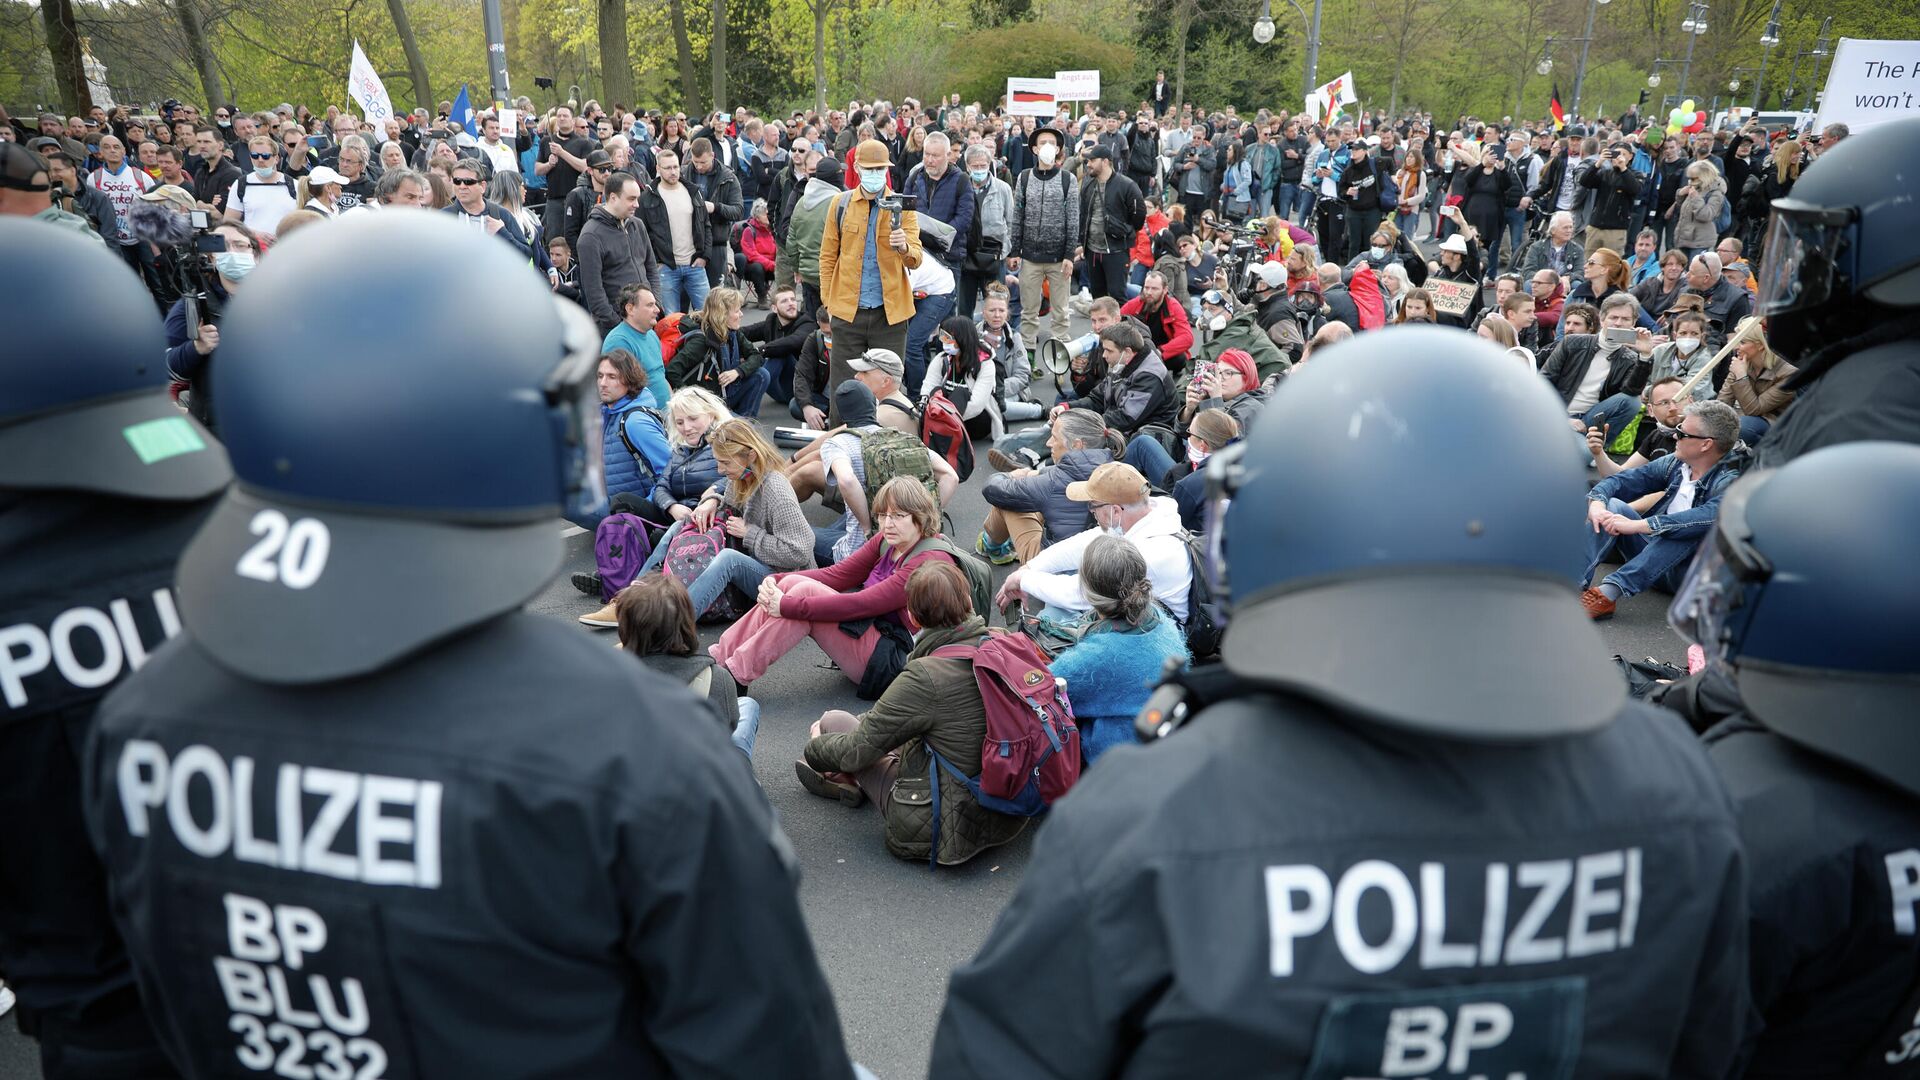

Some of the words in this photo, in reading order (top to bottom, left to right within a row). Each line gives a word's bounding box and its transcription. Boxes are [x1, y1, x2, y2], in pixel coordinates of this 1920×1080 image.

[1855, 91, 1913, 109] won't
[1865, 61, 1905, 79] The
[1438, 283, 1460, 296] DARE
[235, 509, 331, 590] 20
[117, 739, 443, 889] POLIZEI
[223, 892, 328, 971] BP
[1264, 846, 1643, 977] POLIZEI
[212, 955, 370, 1036] BLU
[228, 1012, 388, 1080] 3232
[1380, 1002, 1514, 1077] BP
